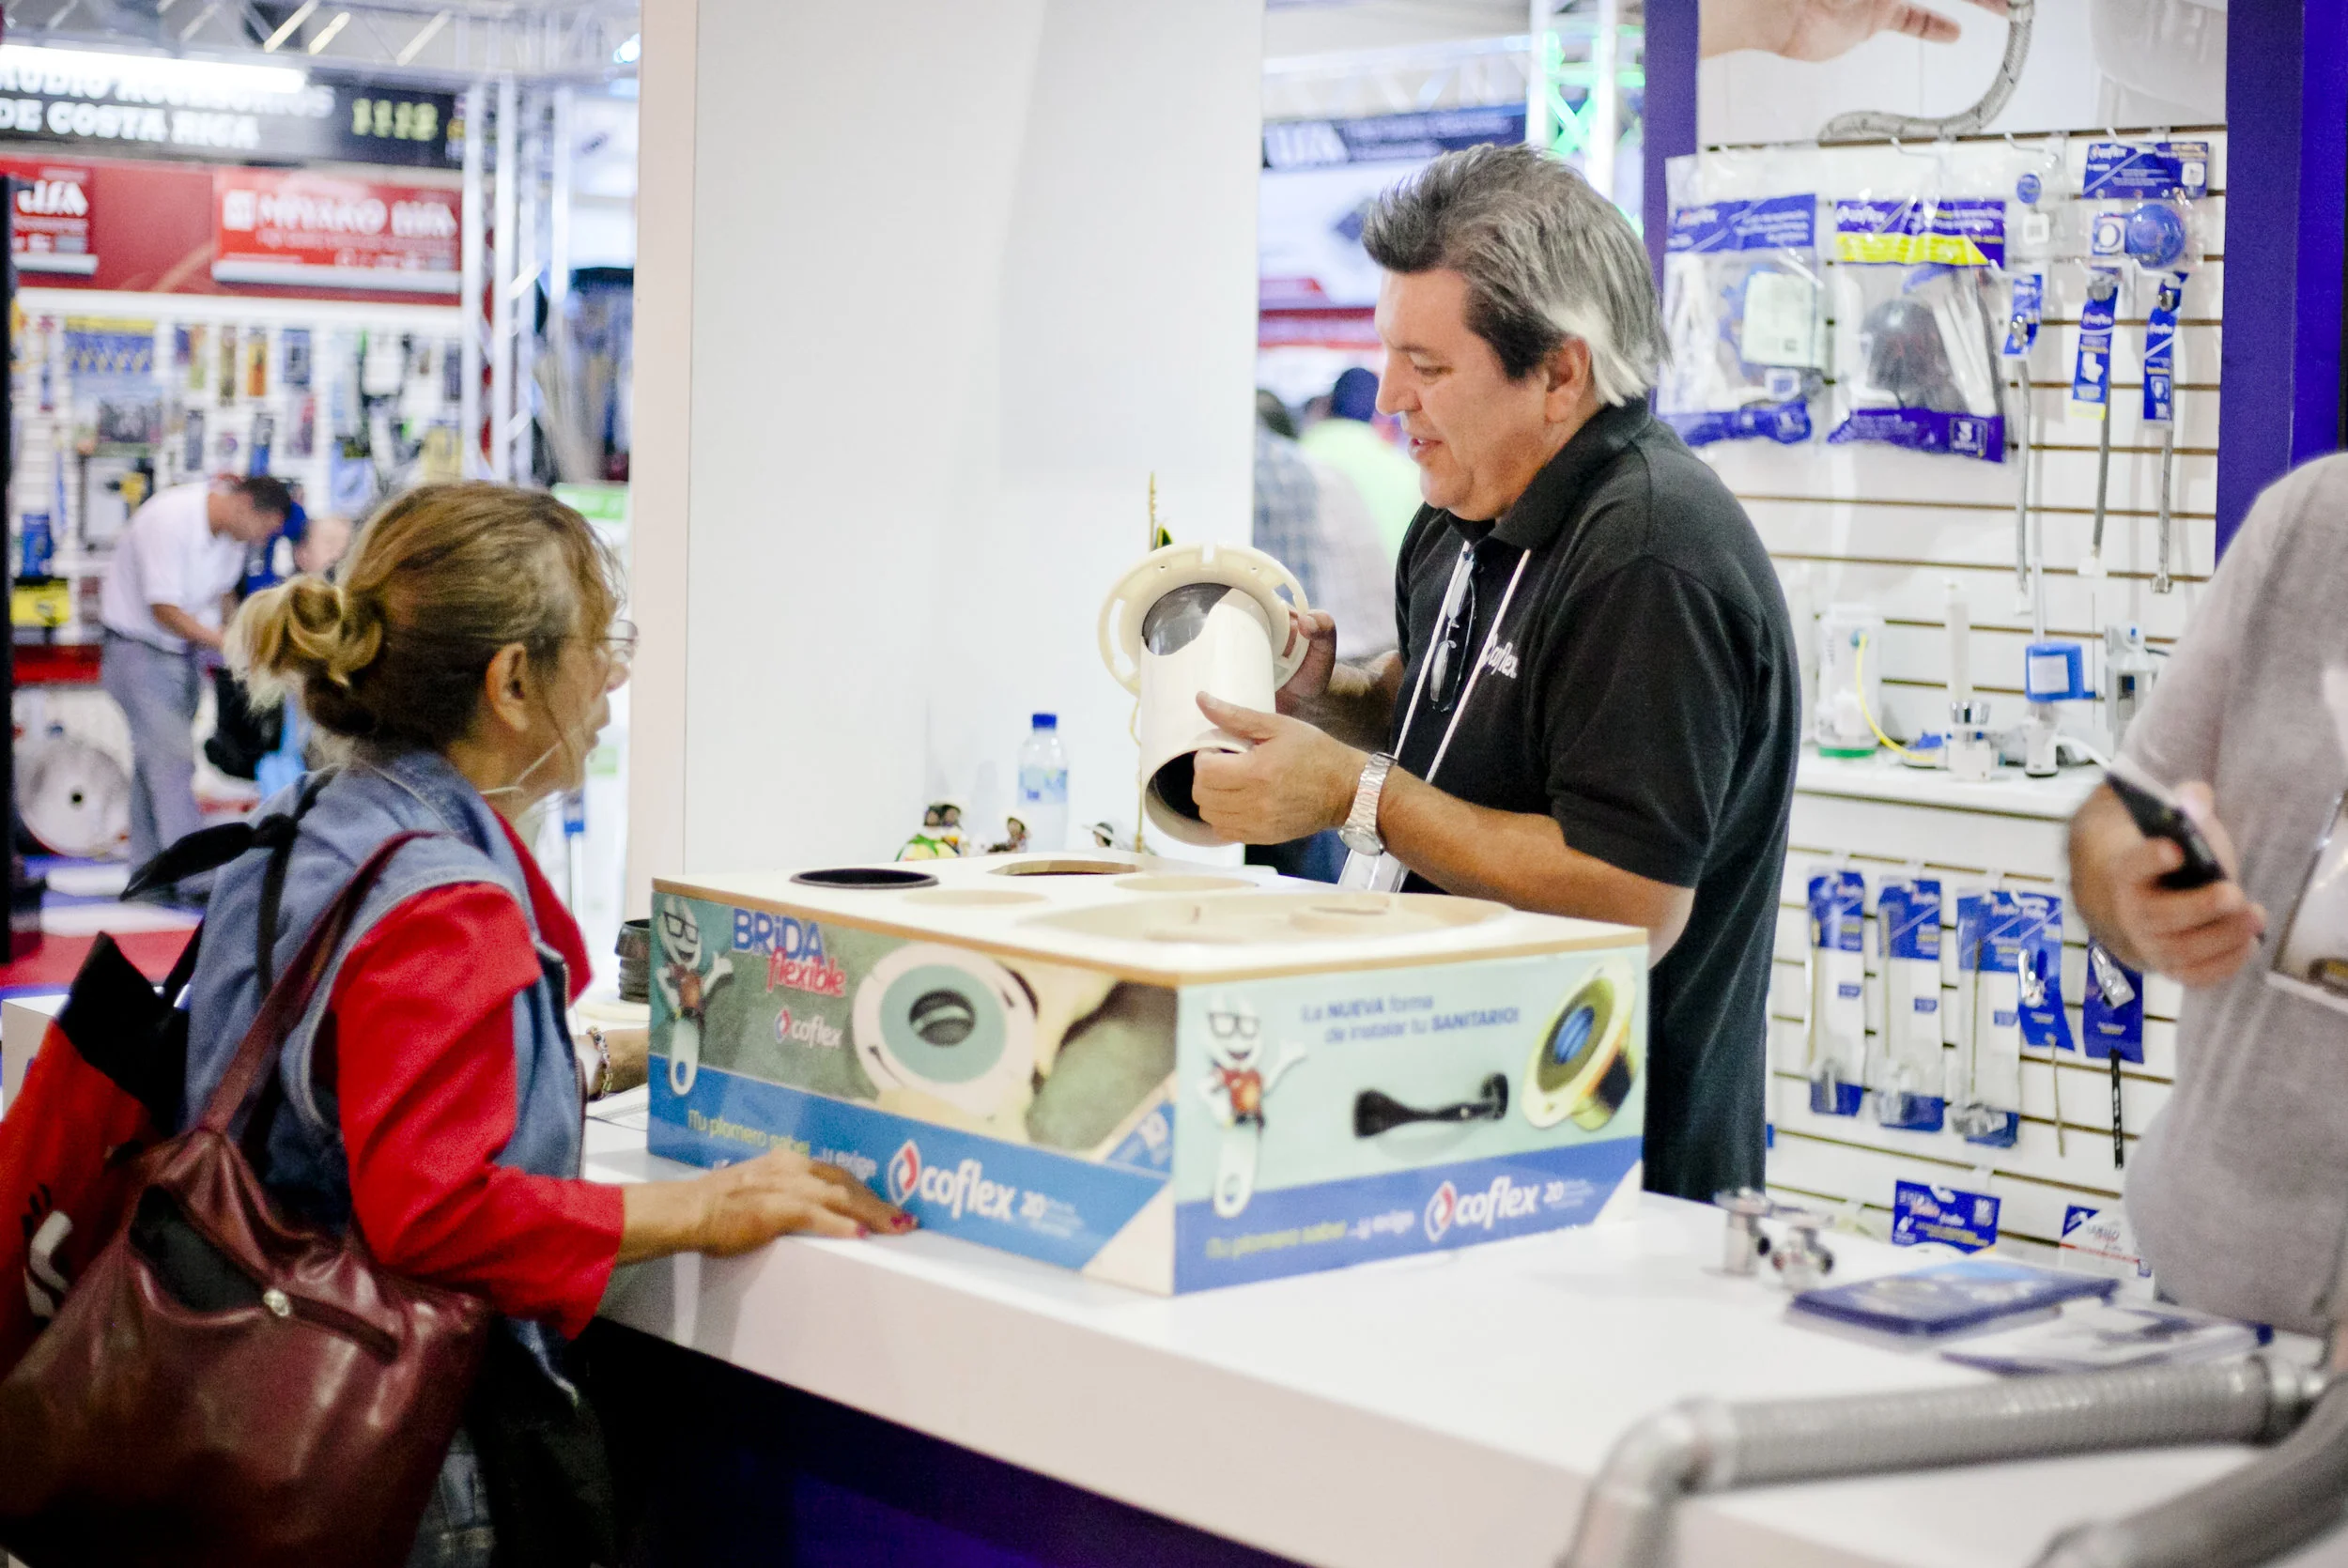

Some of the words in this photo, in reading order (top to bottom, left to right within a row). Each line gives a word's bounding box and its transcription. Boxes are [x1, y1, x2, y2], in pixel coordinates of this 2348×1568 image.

[47, 100, 169, 143] COSTA
[766, 946, 846, 997] flexible
[791, 1015, 843, 1049] coflex
[919, 1159, 1017, 1221] coflex
[1456, 1176, 1539, 1230] coflex
